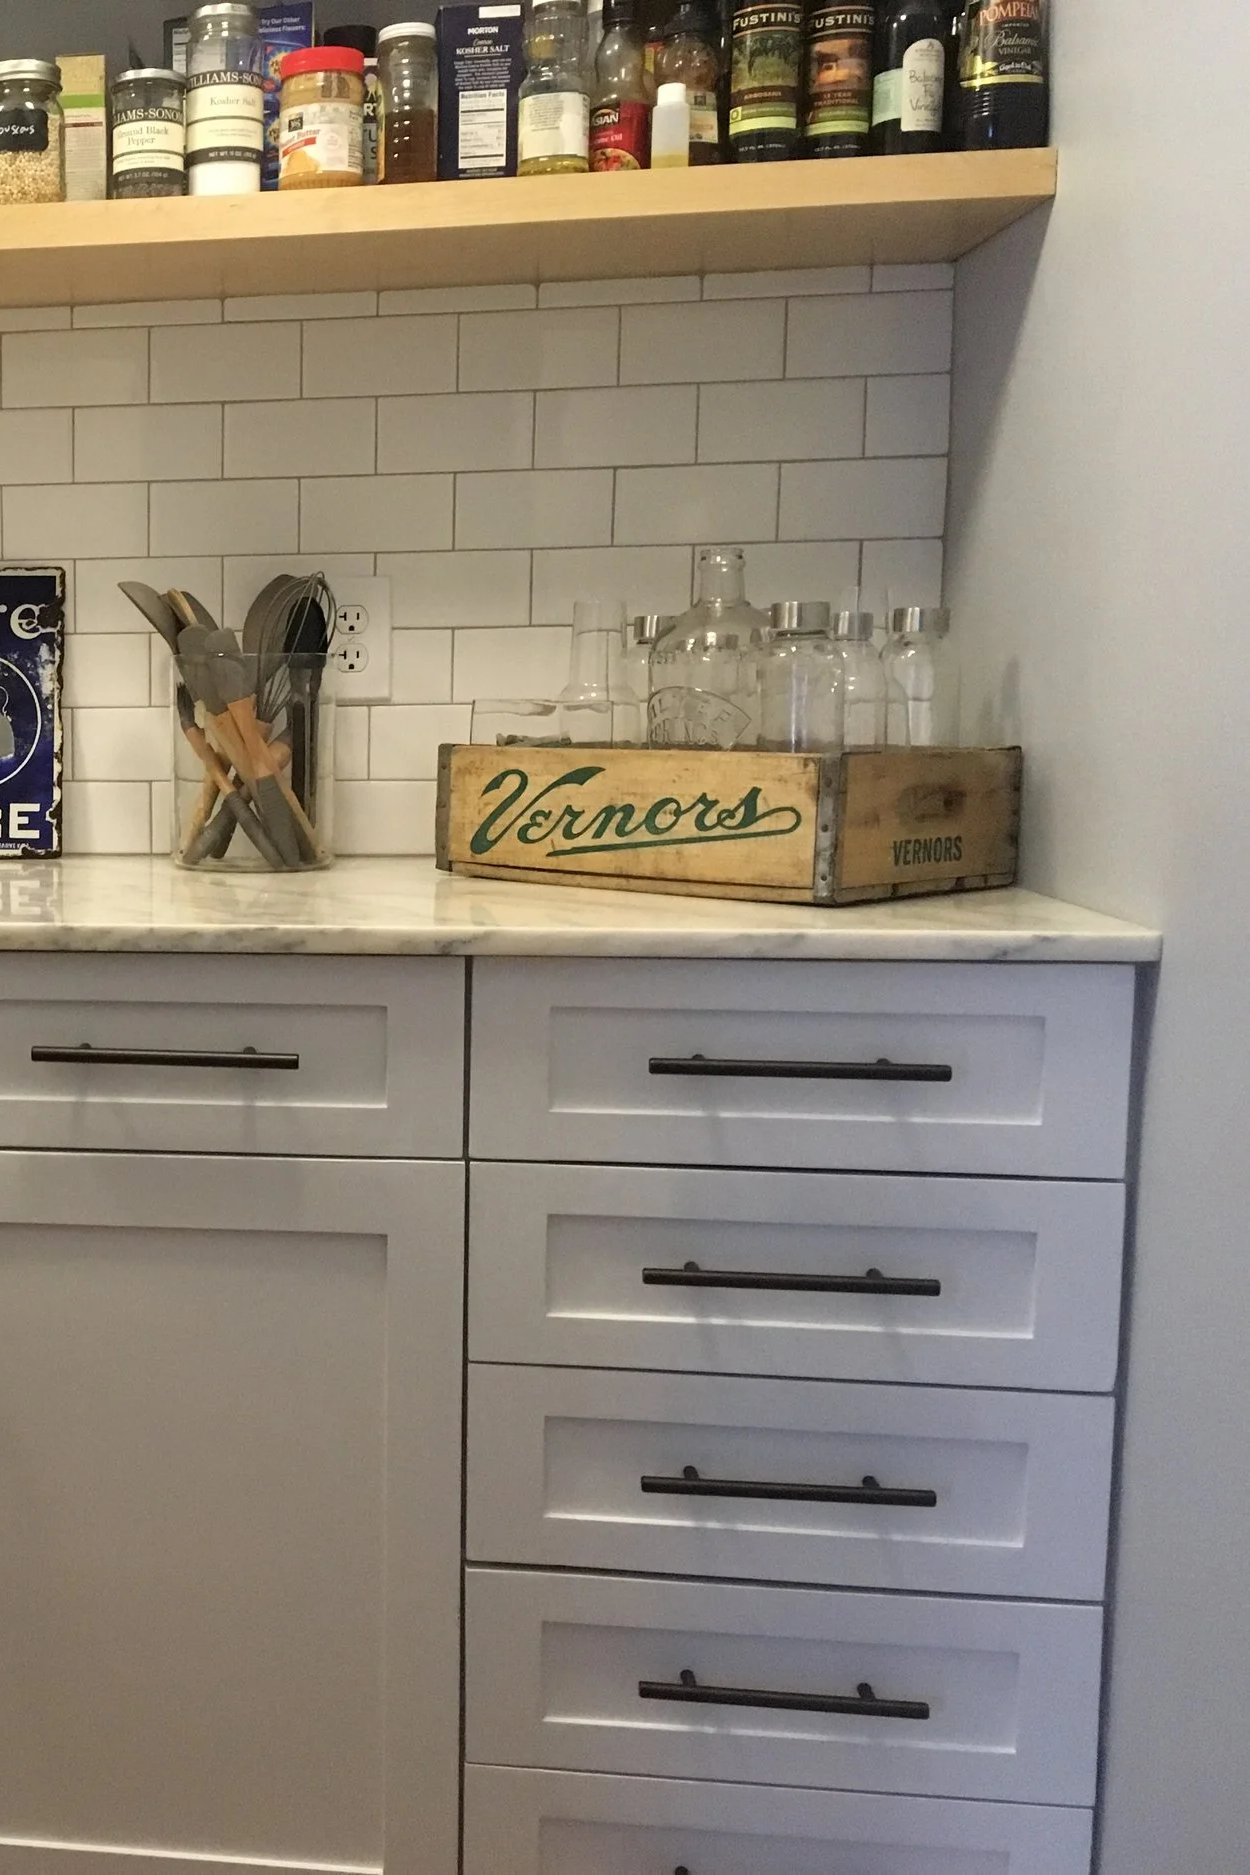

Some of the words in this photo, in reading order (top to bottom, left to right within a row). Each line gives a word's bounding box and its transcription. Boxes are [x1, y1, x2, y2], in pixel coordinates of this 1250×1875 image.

[733, 12, 802, 31] FUSTINI'S
[811, 14, 875, 29] USTINI'S
[468, 26, 499, 35] MORTON
[456, 46, 488, 55] KOSHER
[490, 44, 510, 53] SALT
[210, 96, 240, 107] Kosher
[470, 766, 802, 857] Vernors
[892, 835, 963, 867] VERNORS
